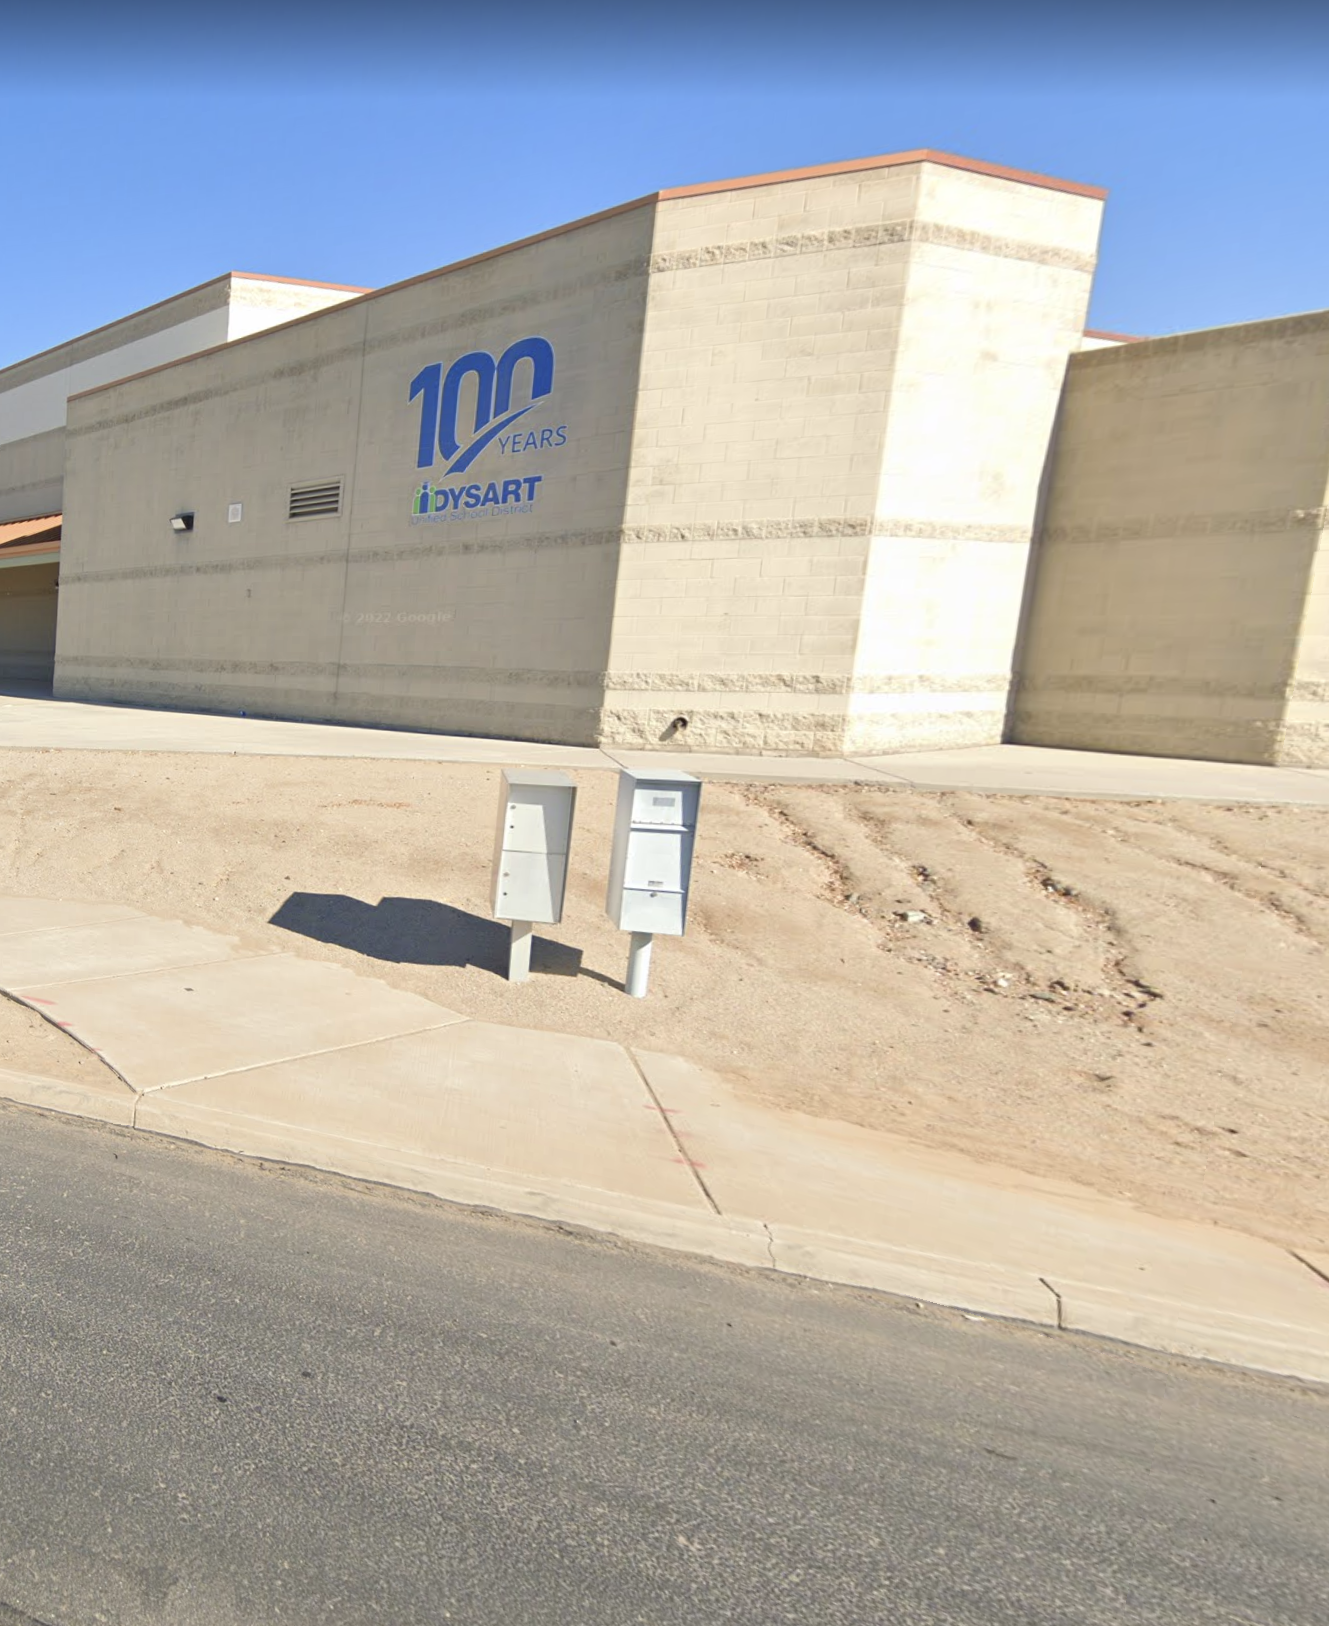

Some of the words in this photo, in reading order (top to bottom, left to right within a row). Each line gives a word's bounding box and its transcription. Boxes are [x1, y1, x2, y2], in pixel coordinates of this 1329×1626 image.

[408, 335, 555, 471] 100
[498, 425, 568, 455] YEARS
[435, 475, 543, 513] DYSART
[410, 509, 447, 527] Unified
[450, 506, 488, 523] School
[491, 503, 534, 518] District
